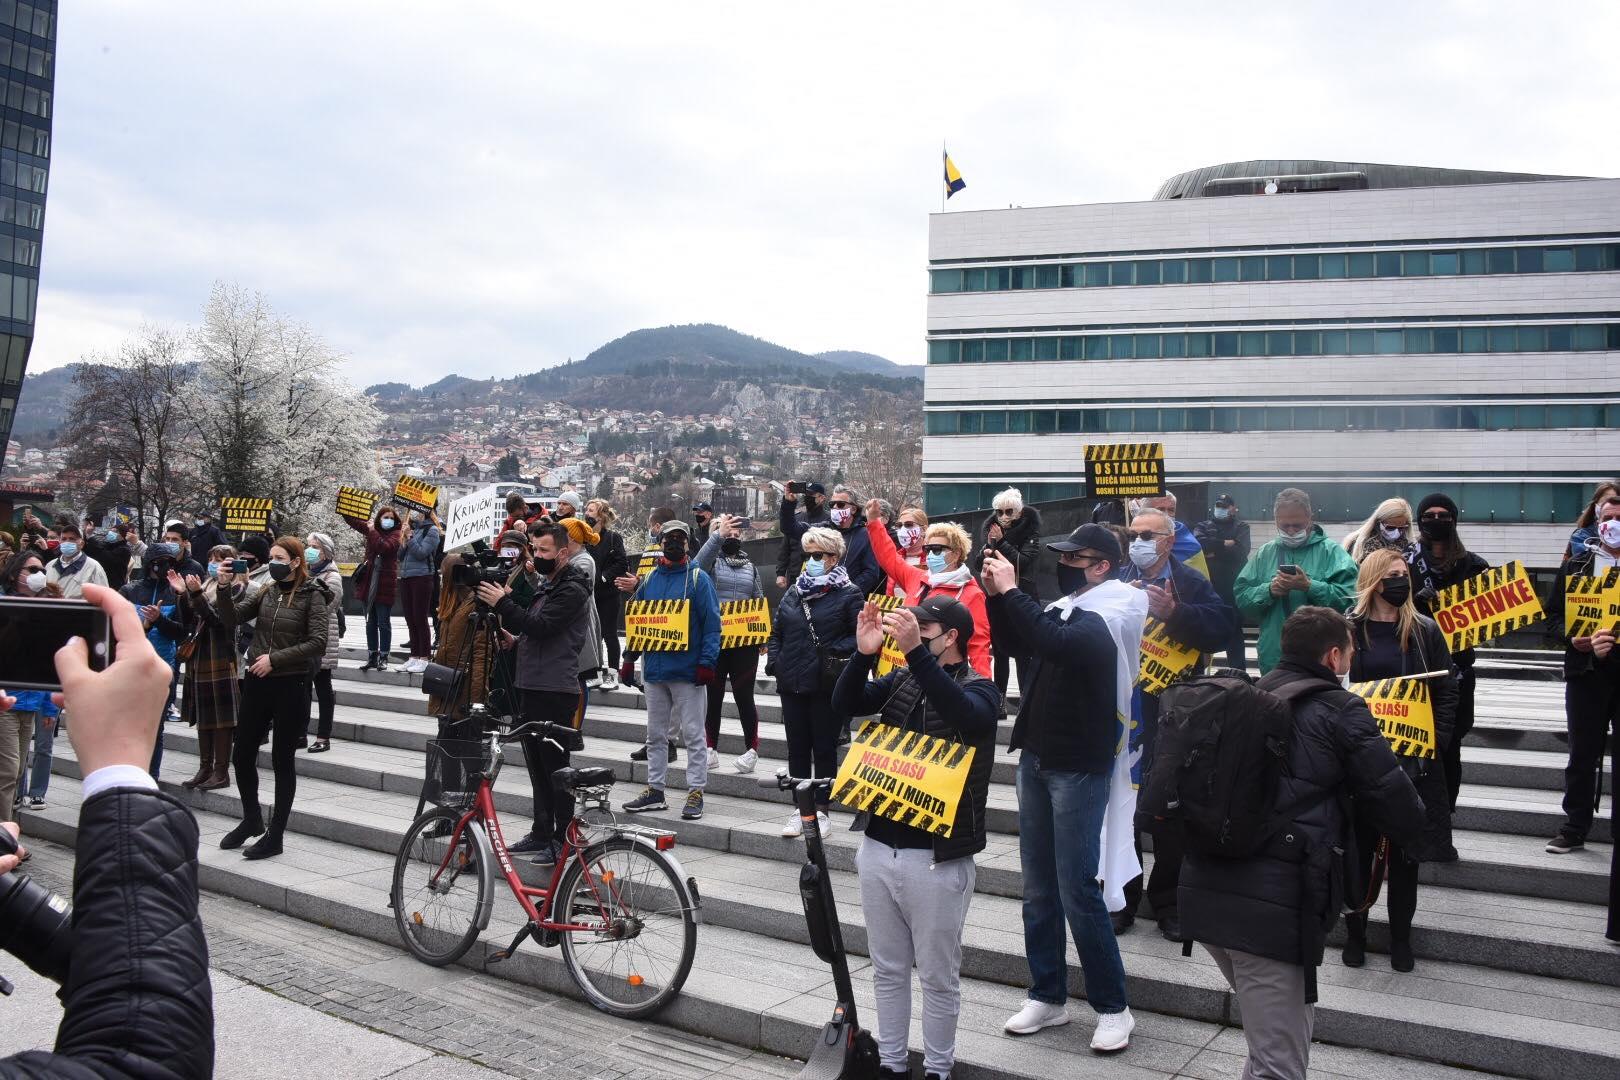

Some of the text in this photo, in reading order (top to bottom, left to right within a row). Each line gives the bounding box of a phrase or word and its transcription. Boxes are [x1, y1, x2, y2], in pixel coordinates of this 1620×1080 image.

[1094, 461, 1158, 475] OSTAVKA
[1095, 474, 1159, 485] VIJEĆA MINISTARA
[1095, 487, 1115, 495] BOSNE
[1118, 486, 1159, 495] HERCEGOVINE
[227, 509, 267, 518] OSTAVKA
[451, 515, 491, 544] NEMAR
[1437, 578, 1534, 634] OSTAVKE
[1567, 596, 1601, 604] PRESTANITE
[635, 616, 648, 625] SMO
[747, 622, 767, 632] UBIJA
[635, 626, 639, 635] A
[640, 626, 647, 636] VI
[647, 627, 659, 638] STE
[1375, 702, 1409, 718] SJAŠU
[1388, 721, 1393, 734] I
[1394, 722, 1429, 744] MURTA
[861, 750, 927, 781] NEKA SJAŠU
[853, 762, 946, 818] I KURTA I MURTA
[488, 818, 512, 873] FISCHER
